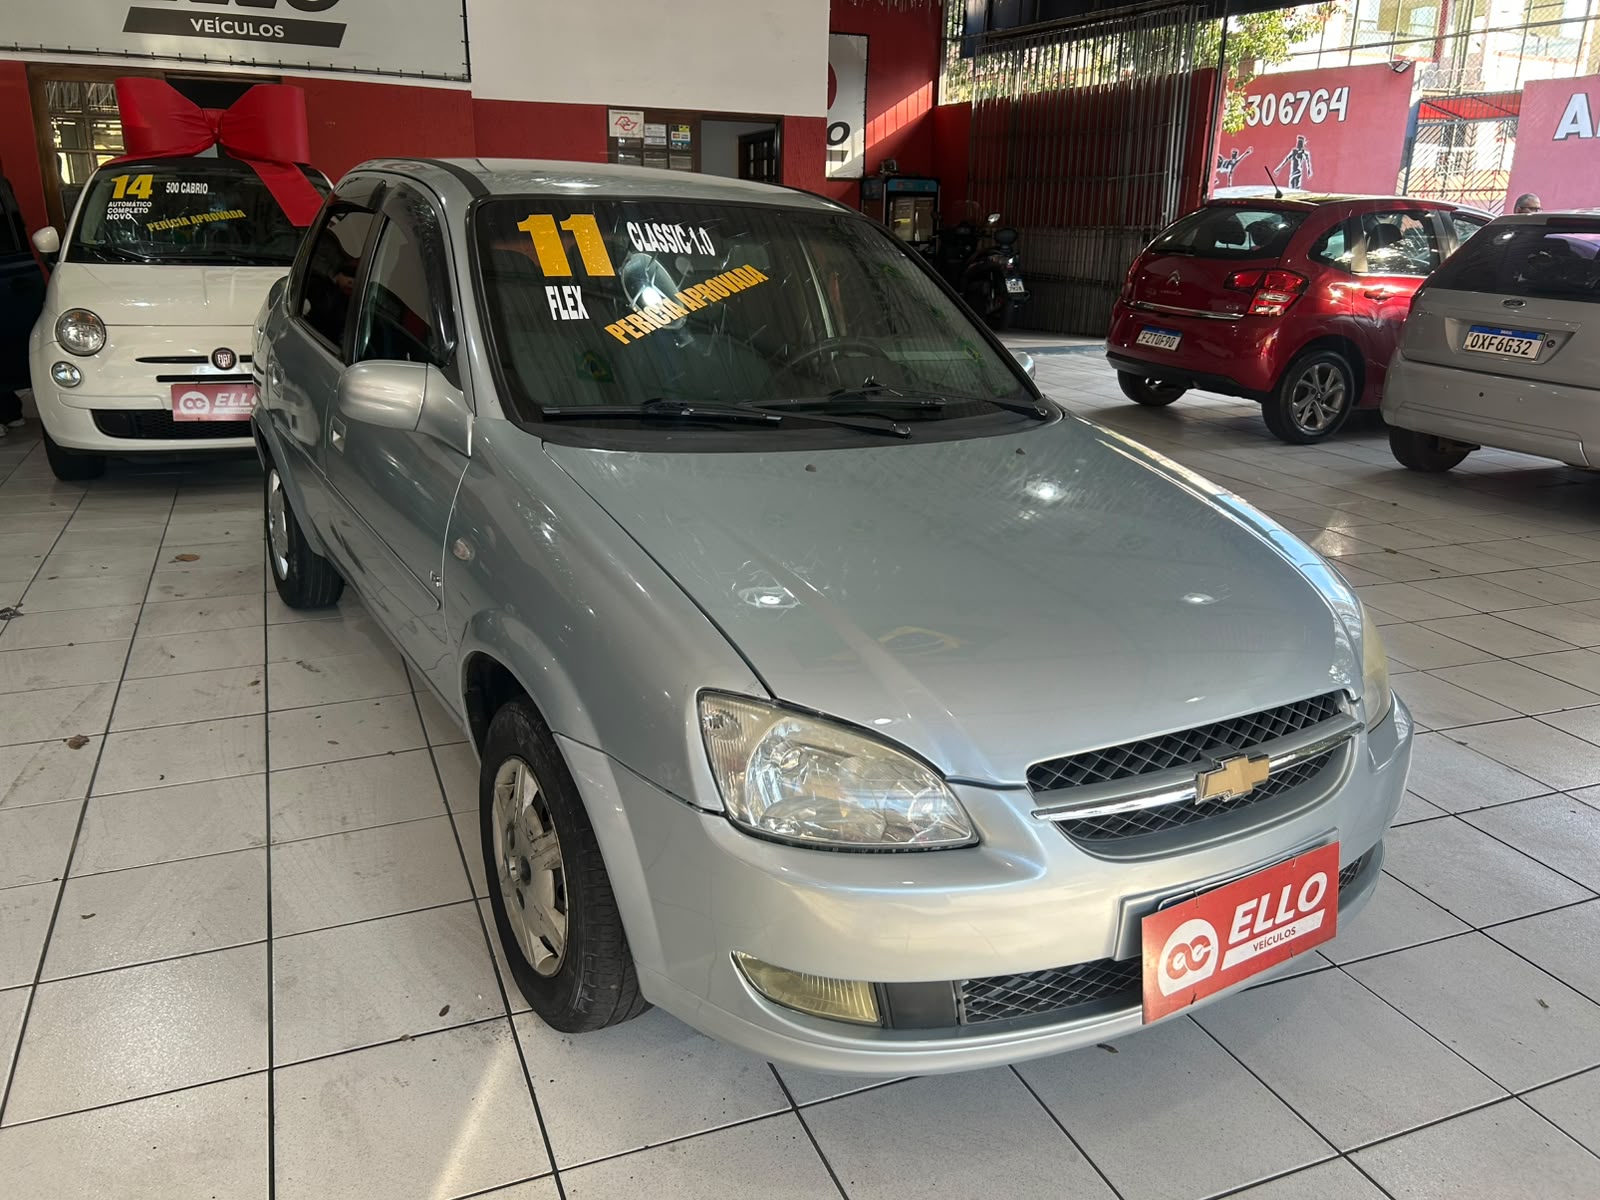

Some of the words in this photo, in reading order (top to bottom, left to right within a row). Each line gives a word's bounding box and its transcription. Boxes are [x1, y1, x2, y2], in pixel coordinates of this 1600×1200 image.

[190, 17, 285, 39] VEÍCULOS
[111, 173, 154, 200] 14
[165, 182, 180, 194] 500
[180, 182, 208, 195] CABRIO
[107, 207, 149, 215] COMPLETO
[190, 209, 247, 225] APROVADA
[517, 213, 615, 277] 11
[626, 221, 691, 255] CLASSIC
[688, 227, 715, 257] 1.0
[675, 263, 769, 312] APROVADA
[544, 285, 590, 321] FLEX
[1228, 871, 1328, 944] ELLO
[1253, 926, 1297, 952] VEÍCULOS
